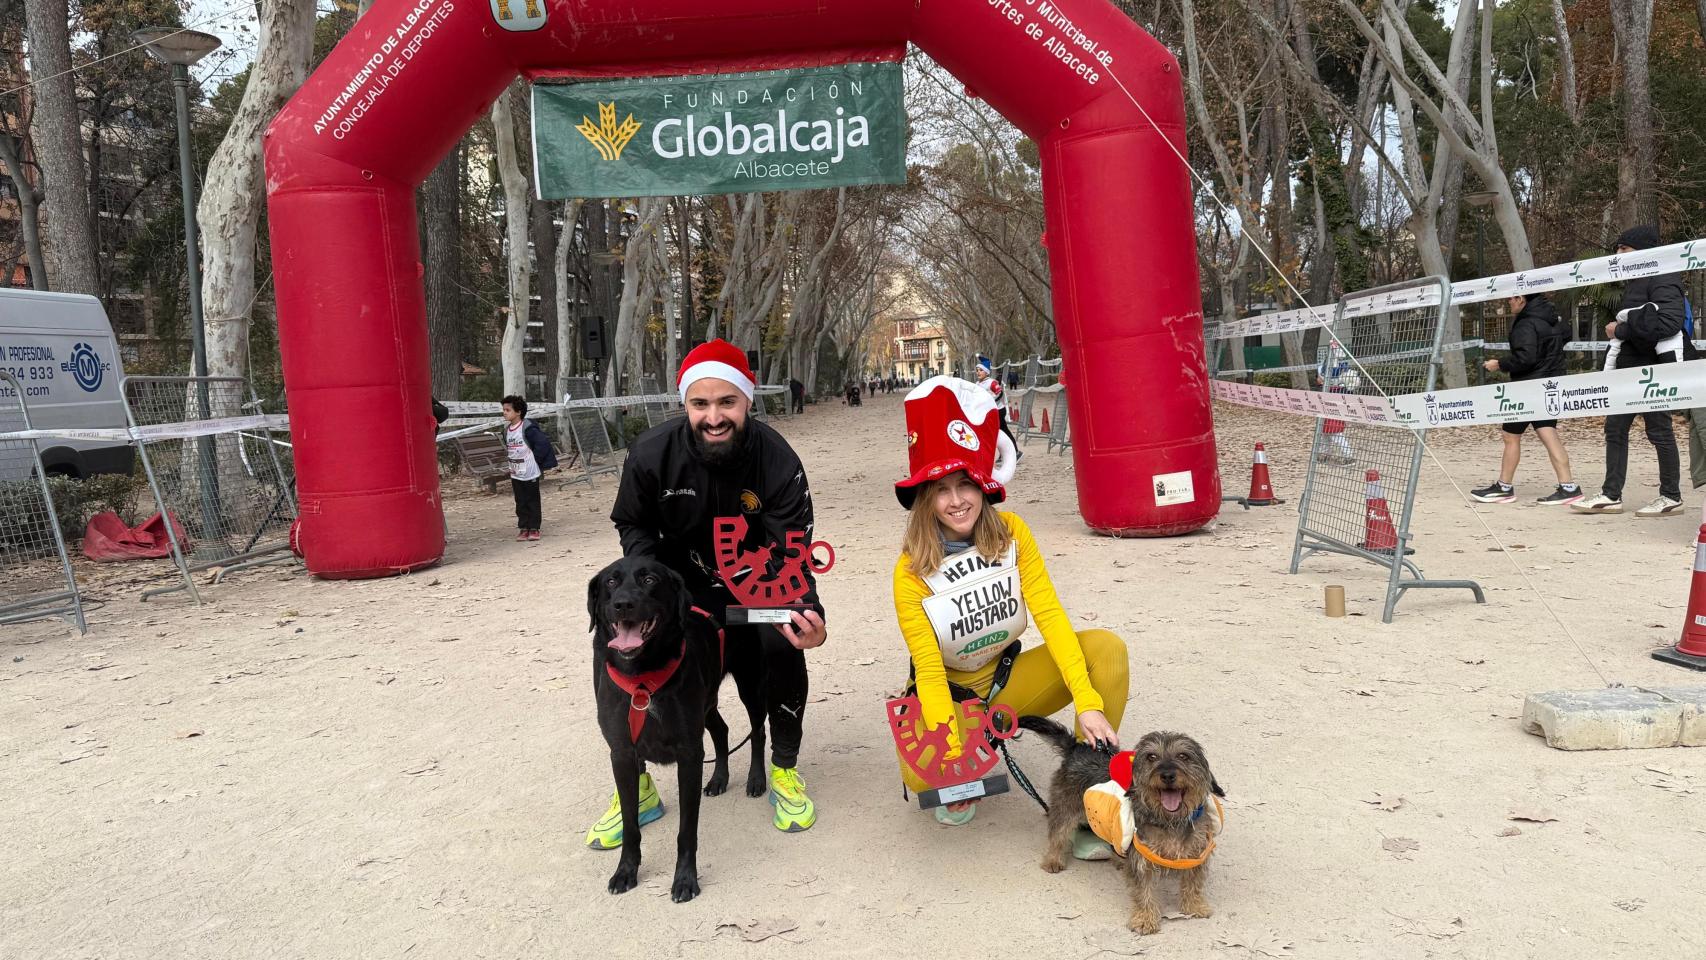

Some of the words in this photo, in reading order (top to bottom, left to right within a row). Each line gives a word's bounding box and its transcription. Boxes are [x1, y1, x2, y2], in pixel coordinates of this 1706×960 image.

[1025, 22, 1043, 40] de
[1043, 36, 1099, 85] Albacete
[1096, 50, 1113, 67] de
[333, 72, 394, 140] CONCEJALÍA
[388, 57, 407, 78] DE
[400, 1, 455, 62] DEPORTES
[313, 53, 384, 136] AYUNTAMIENTO
[382, 35, 400, 56] DE
[664, 80, 863, 109] FUNDACIÓN
[652, 107, 870, 163] Globalcaja
[734, 159, 830, 179] Albacete
[9, 347, 55, 361] PROFESIONAL
[30, 366, 54, 380] 933
[1562, 385, 1609, 399] Ayuntamiento
[1439, 400, 1473, 411] Ayuntamiento
[1440, 410, 1475, 421] ALBACETE
[1563, 398, 1610, 411] ALBACETE
[784, 531, 835, 574] 50
[951, 576, 1012, 617] YELLOW
[950, 598, 1018, 641] MUSTARD
[967, 631, 1005, 651] HEINZ
[961, 697, 1019, 740] 50
